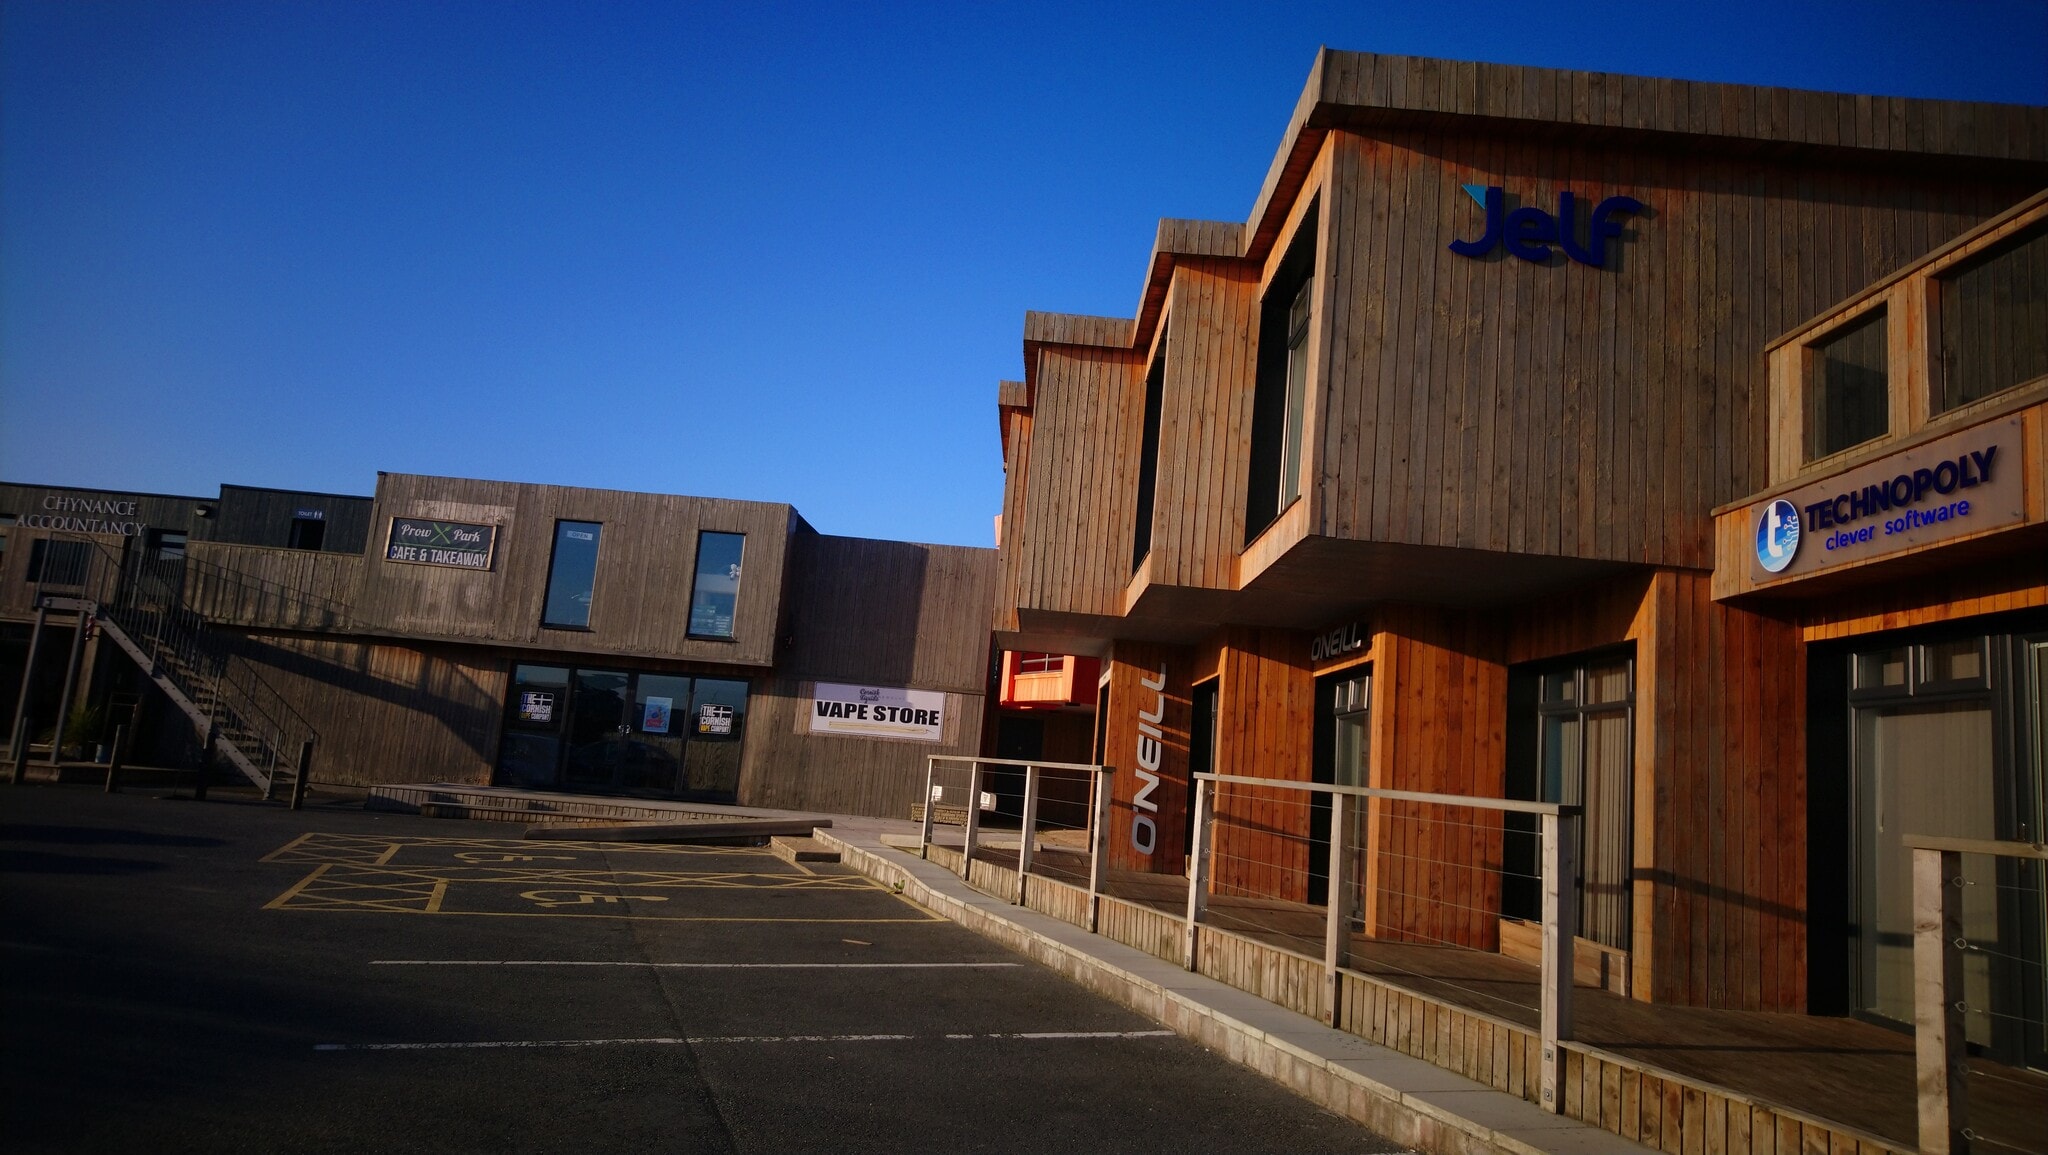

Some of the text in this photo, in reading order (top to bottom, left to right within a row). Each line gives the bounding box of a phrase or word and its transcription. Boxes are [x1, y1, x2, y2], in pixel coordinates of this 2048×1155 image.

[1448, 186, 1644, 265] Jelf
[1805, 445, 1997, 533] TECHNOPOLY
[43, 496, 136, 516] CHYNANCE
[15, 514, 146, 536] ACCOUNTANCY
[401, 524, 481, 542] Prow Park
[1826, 500, 1970, 550] clever software
[390, 546, 487, 567] CAFE & TAKEAWAY
[521, 704, 551, 714] CORNISH
[523, 693, 537, 704] THE
[701, 716, 731, 726] CORNISH
[703, 706, 716, 717] THE
[816, 701, 940, 726] VAPE STORE
[1131, 662, 1167, 855] O'NEILL
